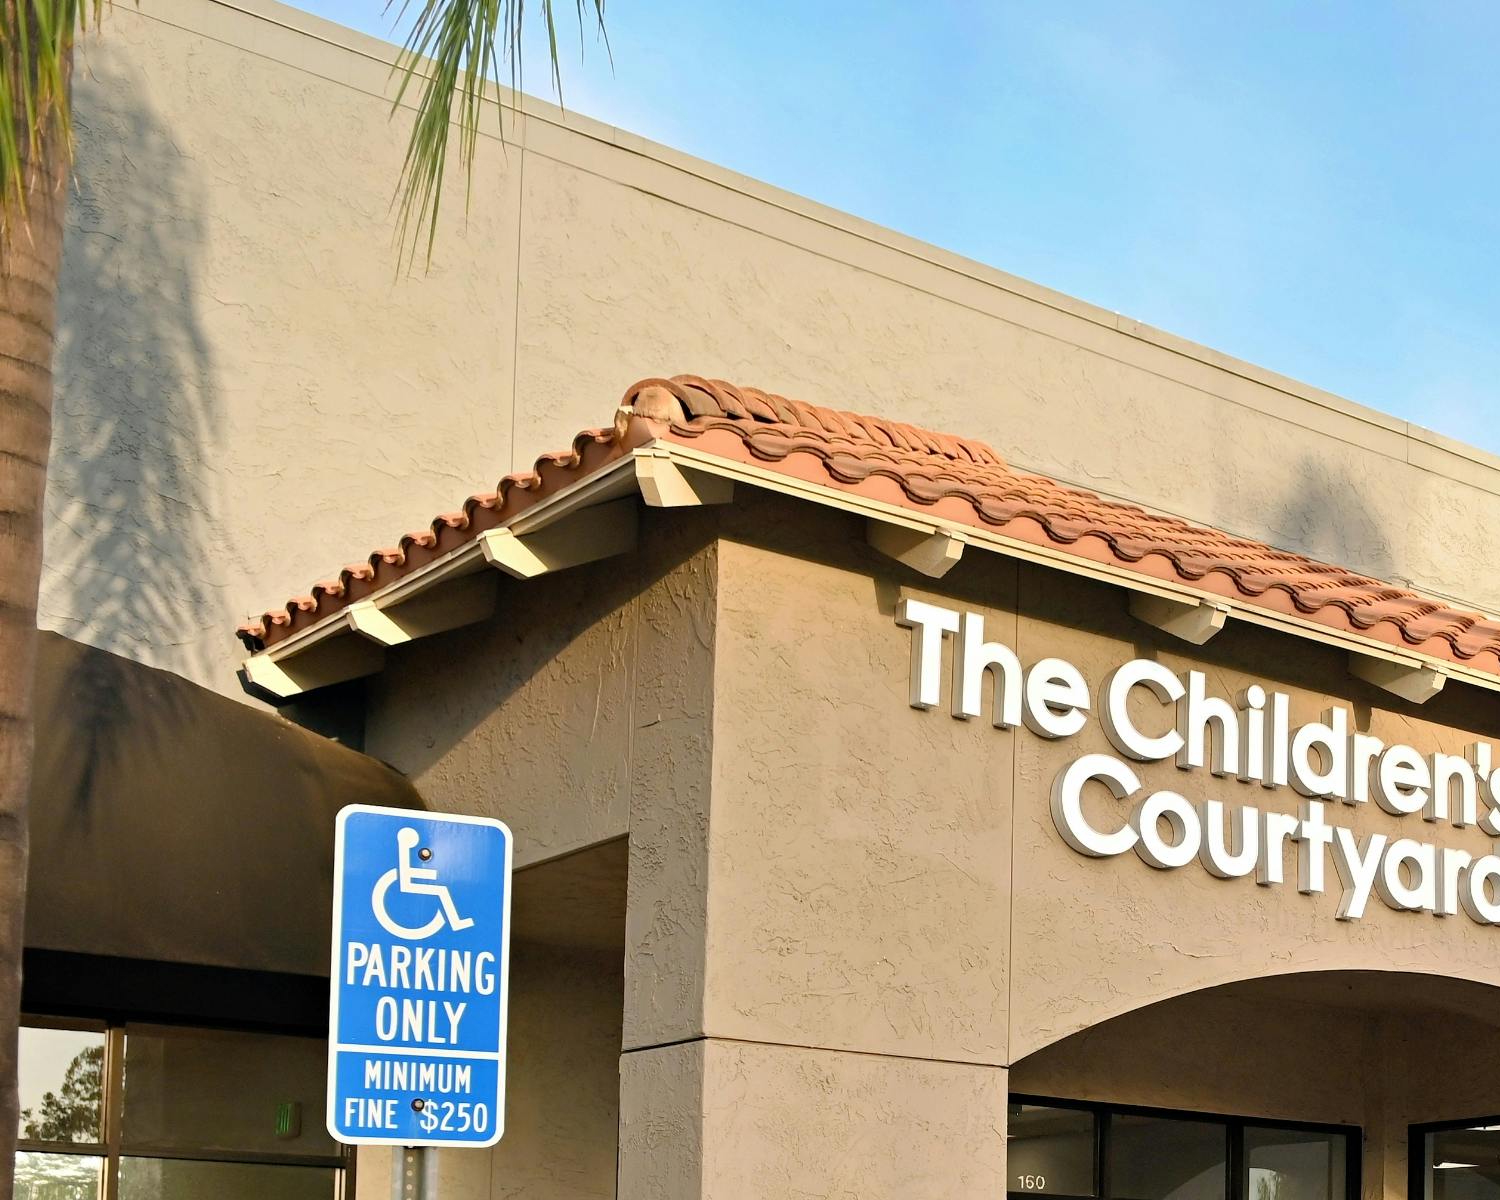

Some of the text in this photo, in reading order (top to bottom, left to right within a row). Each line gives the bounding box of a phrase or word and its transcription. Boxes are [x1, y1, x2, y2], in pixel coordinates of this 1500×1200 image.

[896, 598, 1090, 739] The
[347, 941, 496, 996] PARKING
[375, 996, 467, 1045] ONLY
[364, 1060, 472, 1095] MINIMUM
[344, 1097, 488, 1134] FINE $250
[1017, 1174, 1046, 1190] 160
